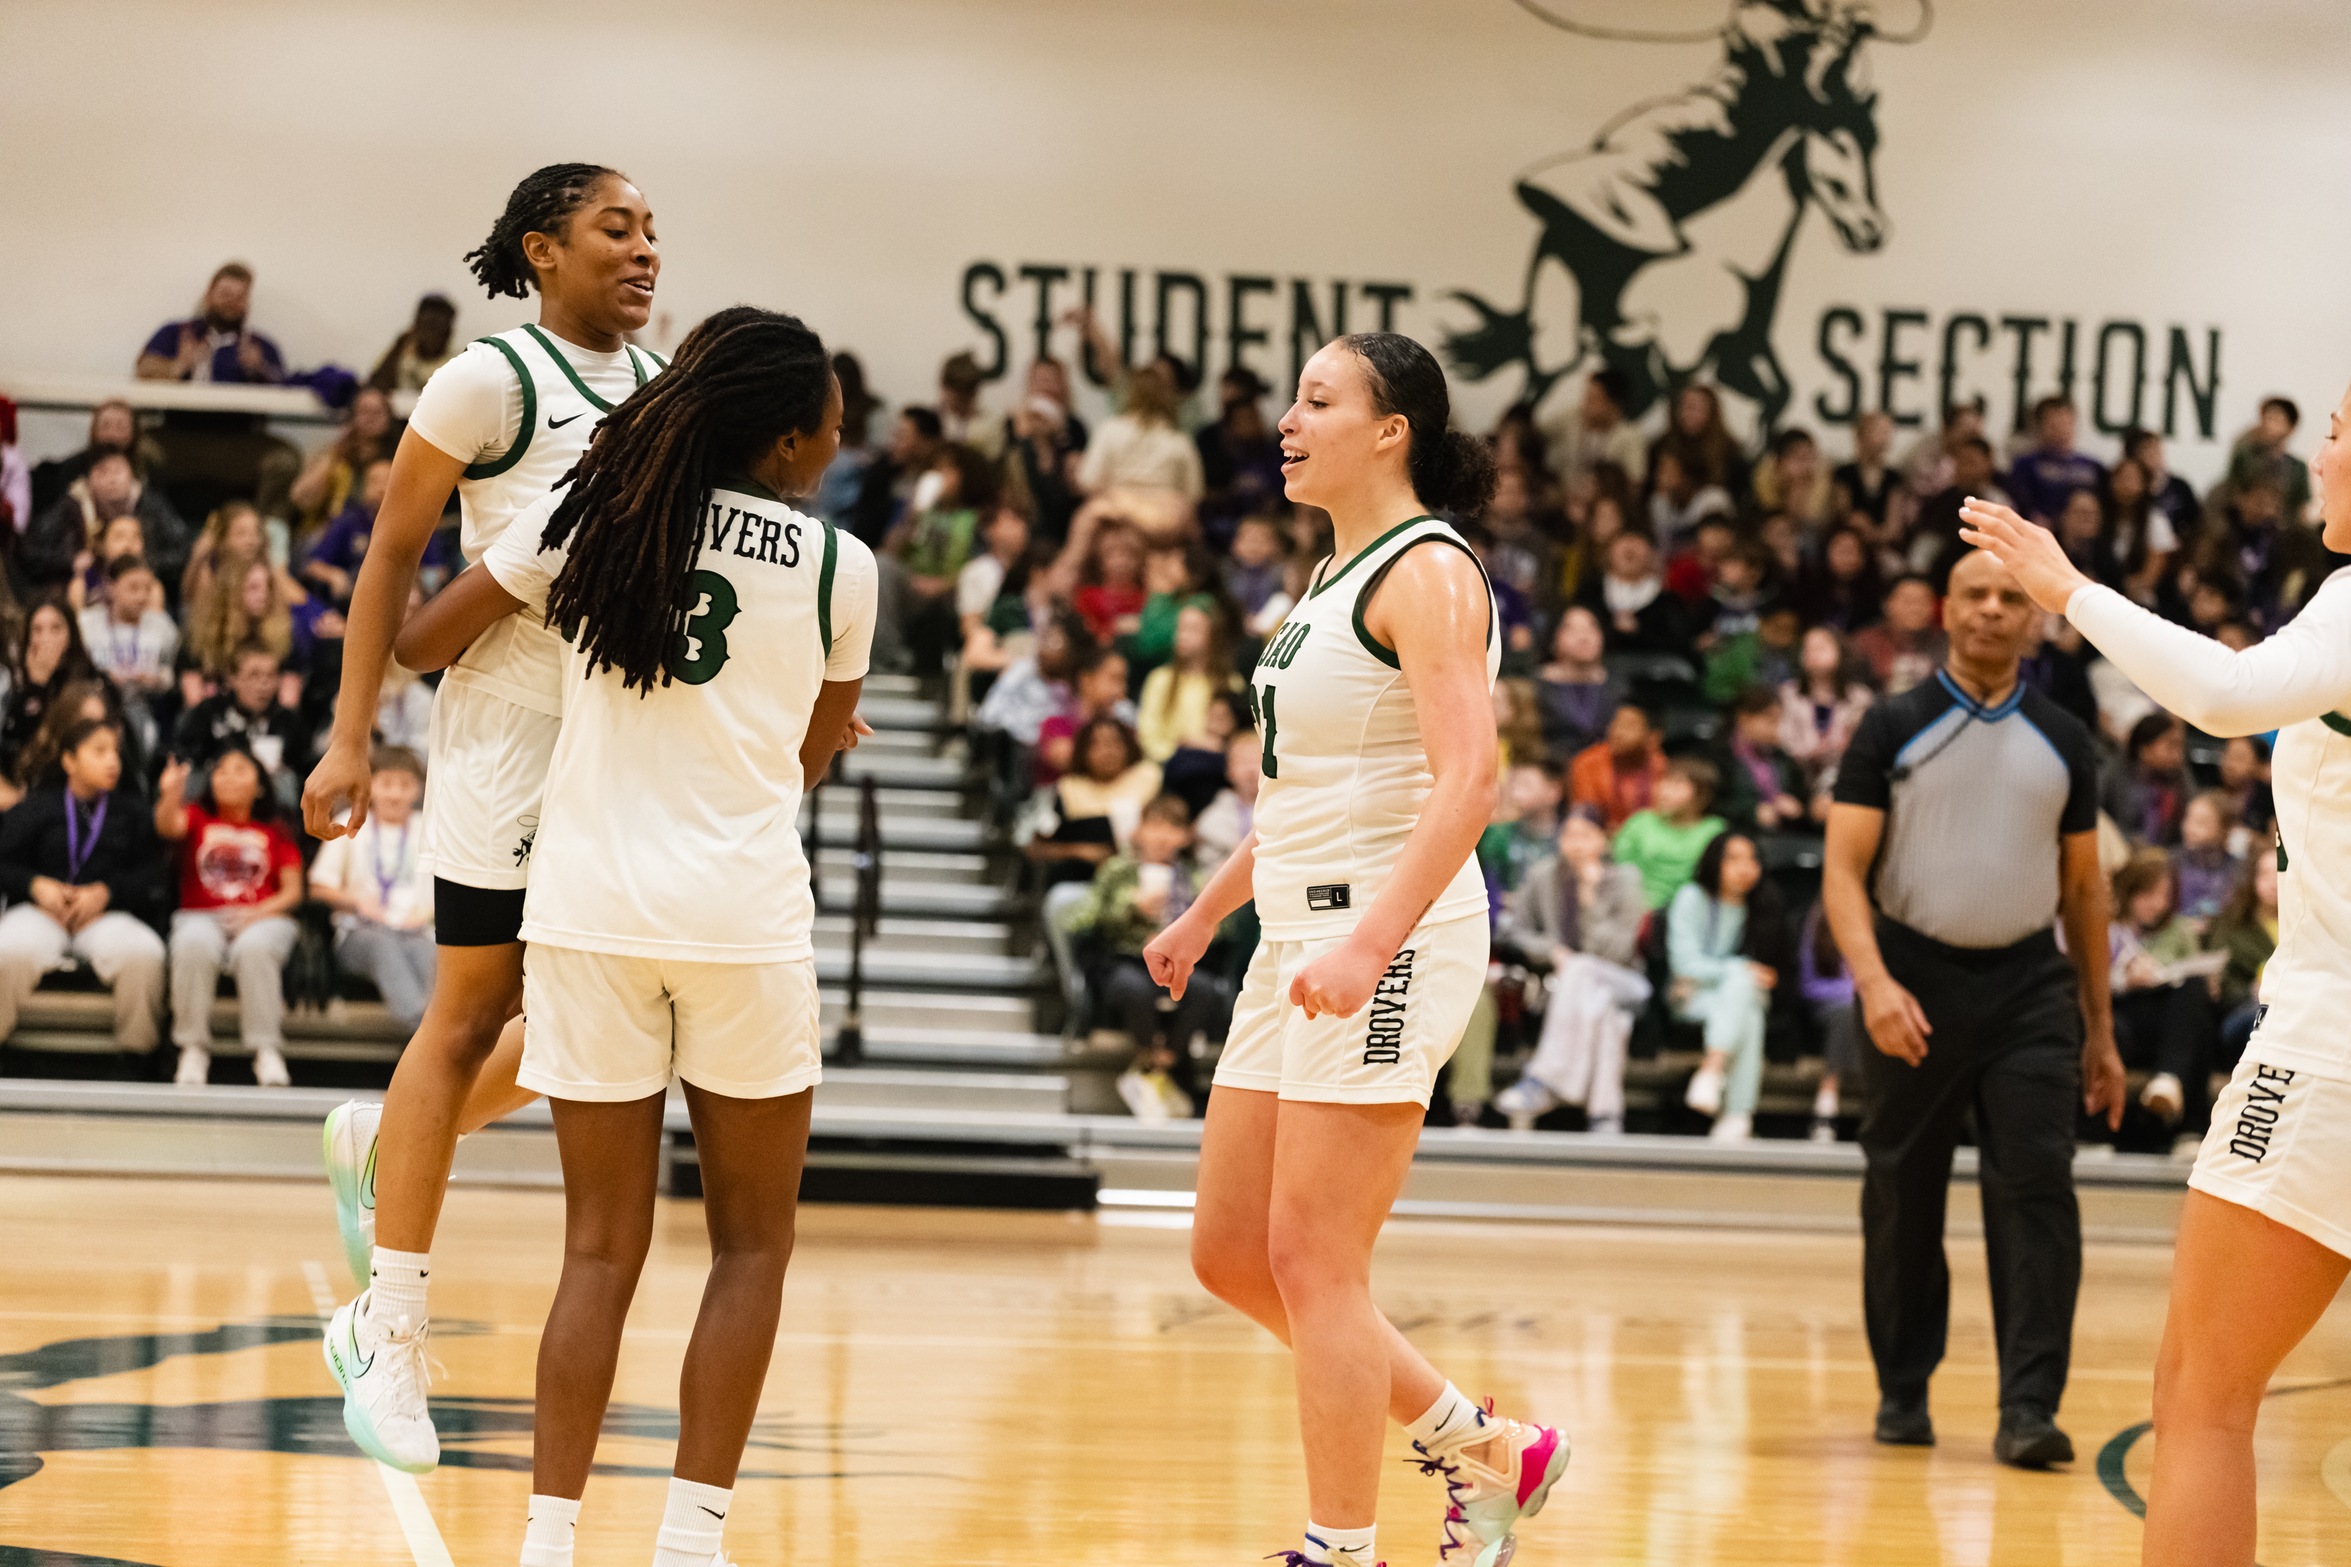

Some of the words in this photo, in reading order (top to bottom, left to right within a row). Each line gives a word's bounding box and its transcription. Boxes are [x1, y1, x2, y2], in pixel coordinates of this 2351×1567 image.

[960, 262, 1412, 400] STUDENT
[1815, 307, 2220, 438] SECTION
[709, 503, 802, 568] VERS
[668, 570, 742, 685] 3
[1336, 891, 1343, 902] L
